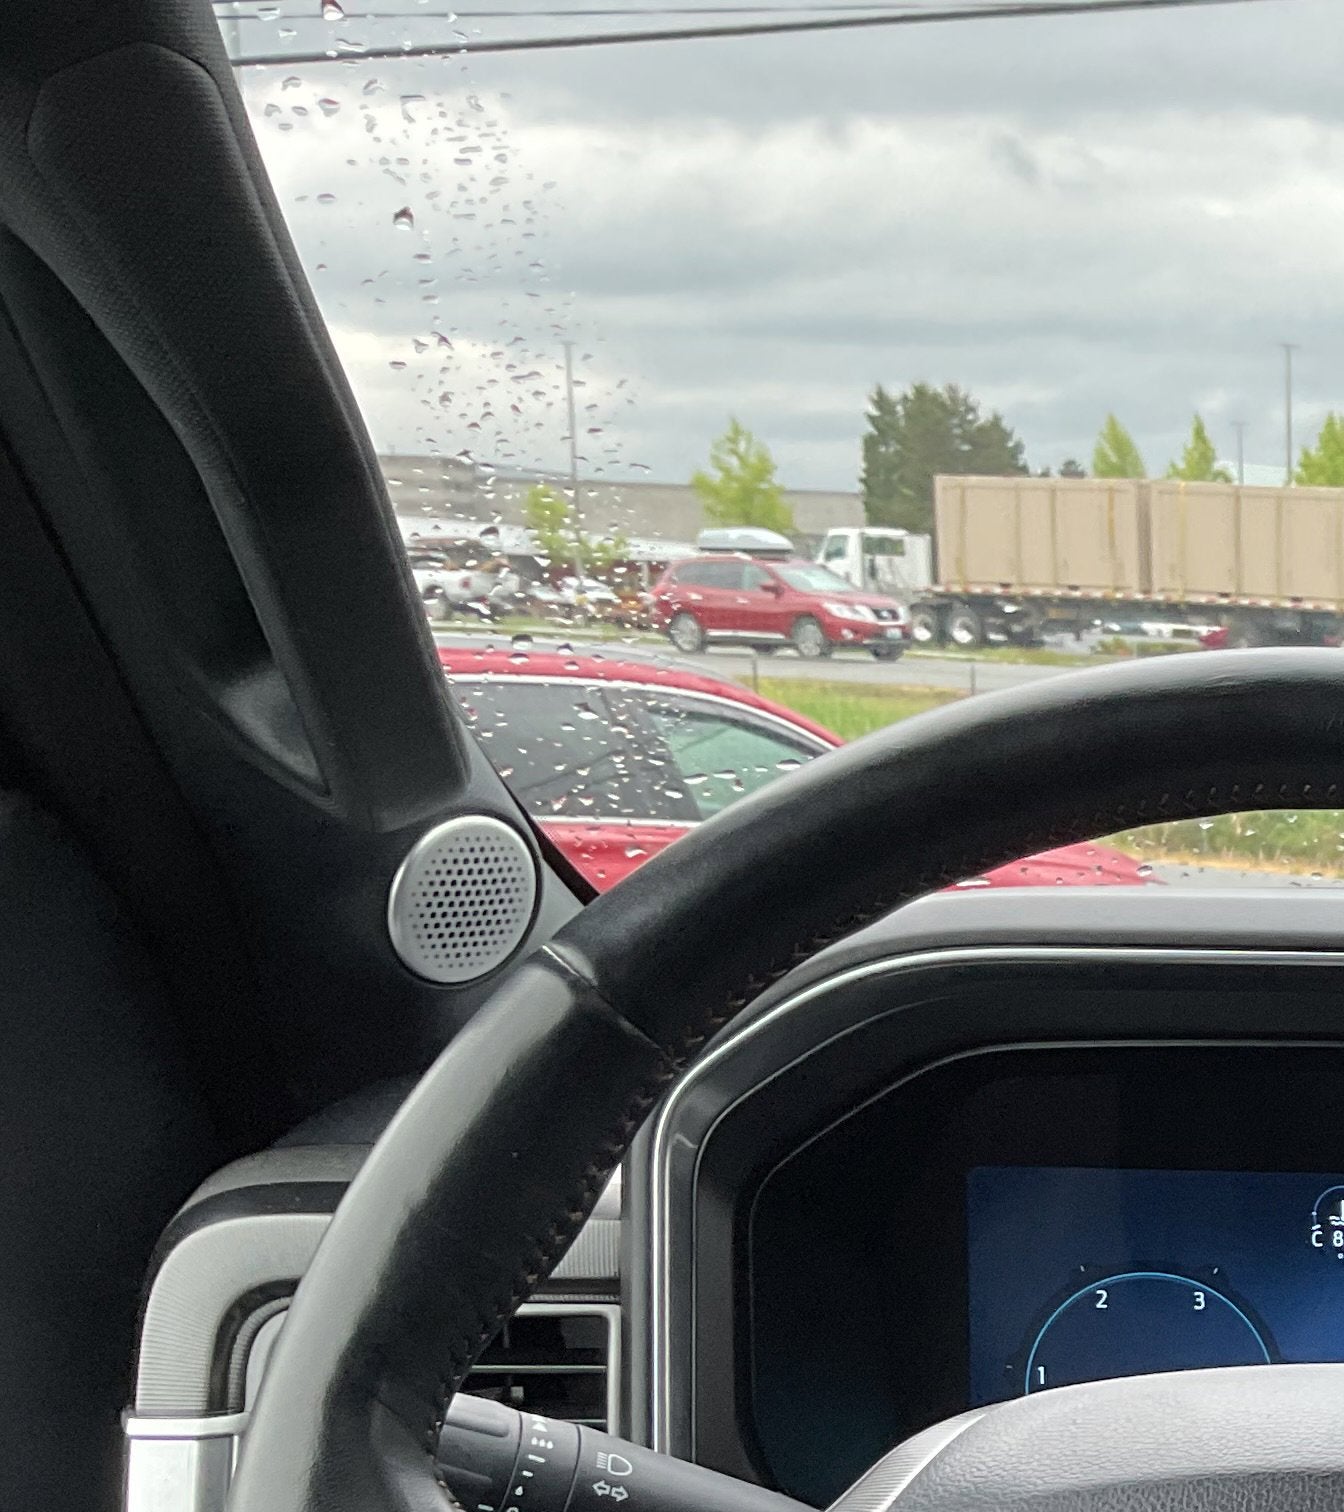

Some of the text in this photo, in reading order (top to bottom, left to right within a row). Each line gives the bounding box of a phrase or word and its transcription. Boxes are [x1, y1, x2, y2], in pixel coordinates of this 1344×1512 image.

[1095, 1289, 1108, 1309] 2
[1193, 1291, 1206, 1311] 3
[1037, 1366, 1047, 1385] 1
